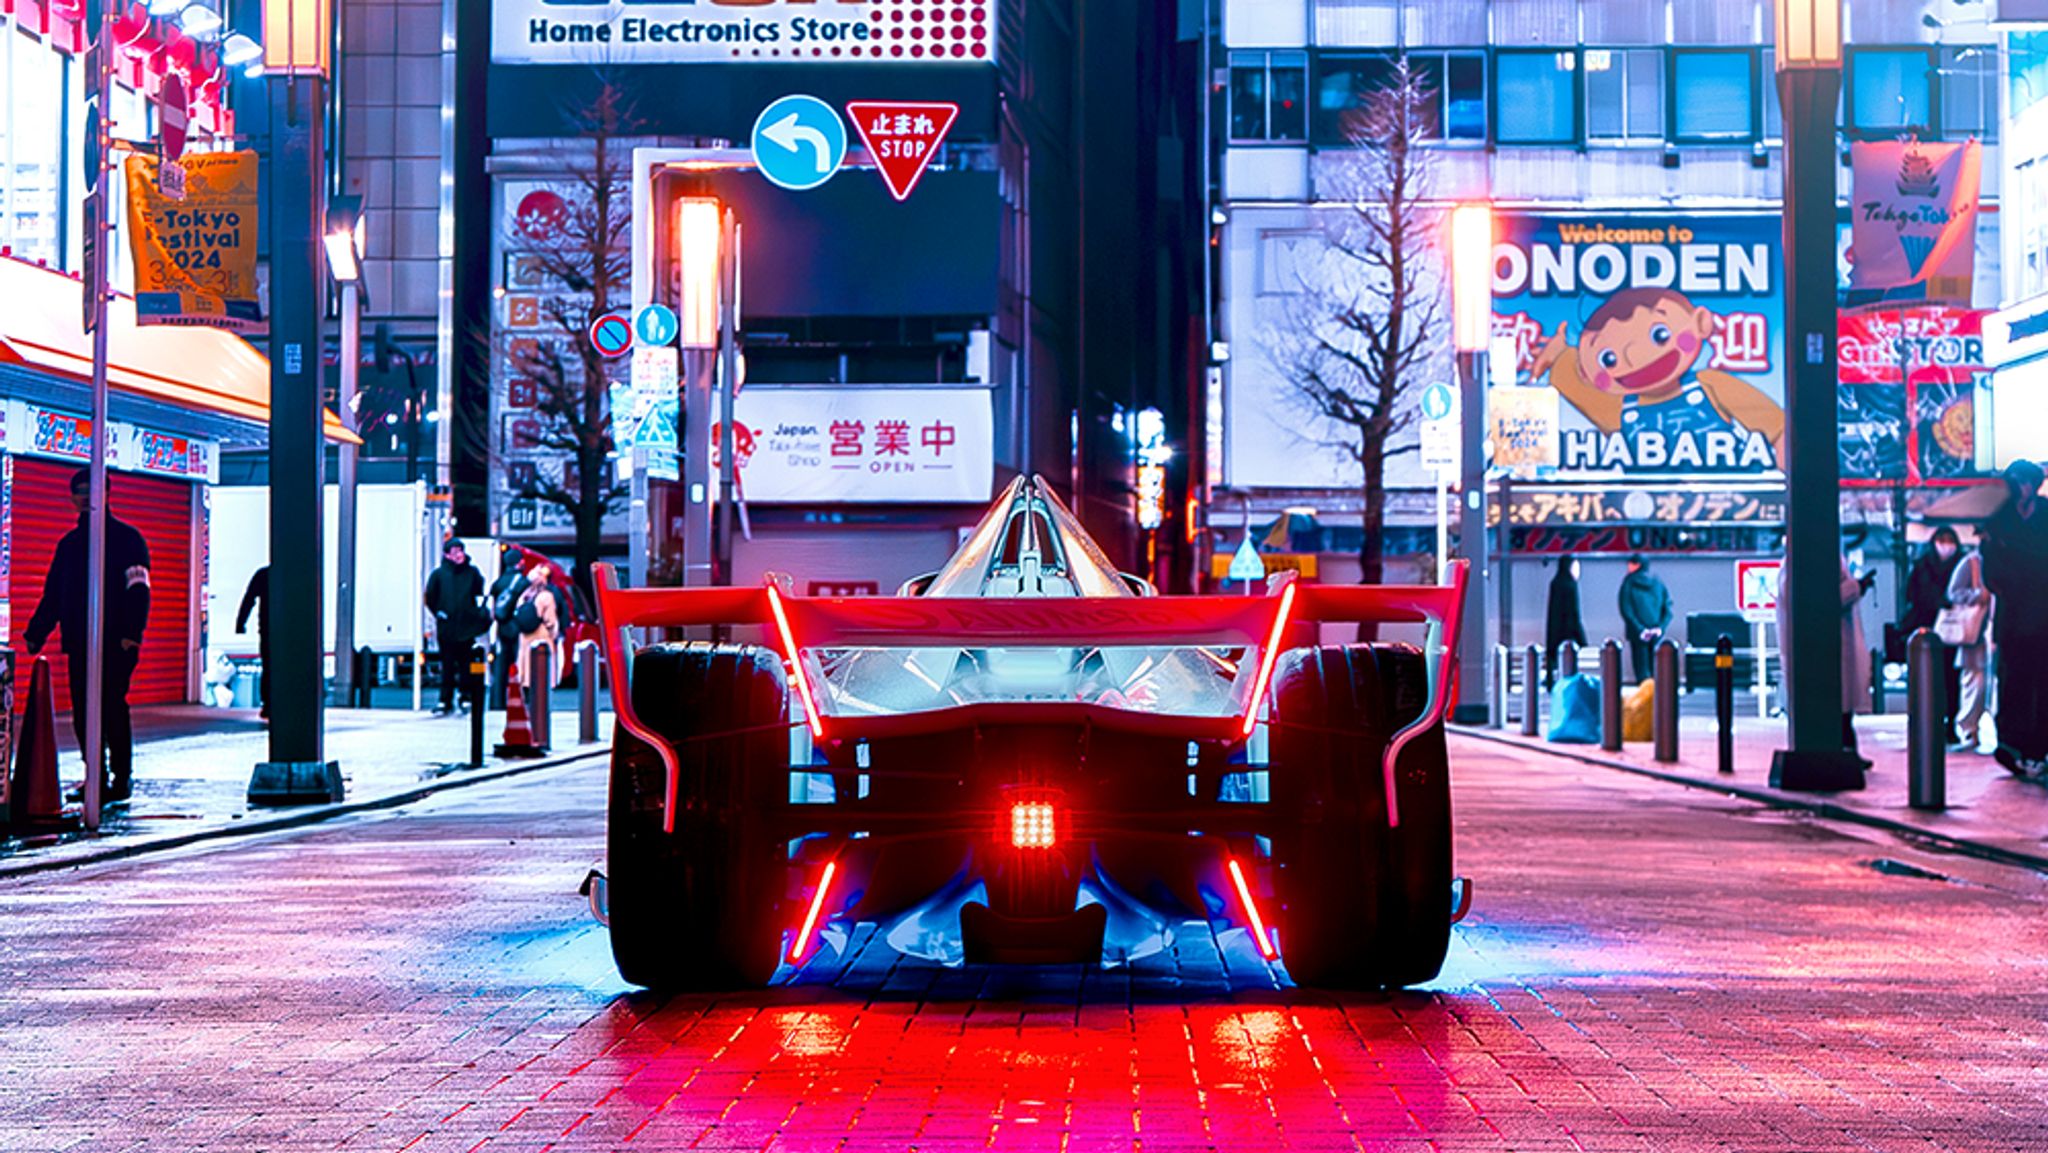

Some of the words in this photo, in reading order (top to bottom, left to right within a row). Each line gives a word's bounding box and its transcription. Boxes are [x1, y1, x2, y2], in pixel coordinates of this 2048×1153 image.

[530, 18, 612, 43] Home
[622, 17, 780, 43] Electronics
[790, 17, 869, 43] Store
[870, 113, 935, 135] 止まれ
[881, 140, 926, 158] STOP
[1559, 224, 1664, 244] Welcome
[1668, 225, 1694, 243] to
[169, 250, 222, 269] 024
[1491, 243, 1769, 293] ONODEN
[1710, 313, 1767, 369] 迎
[829, 419, 956, 457] 営業中
[788, 454, 821, 468] Shop
[869, 461, 915, 473] OPEN
